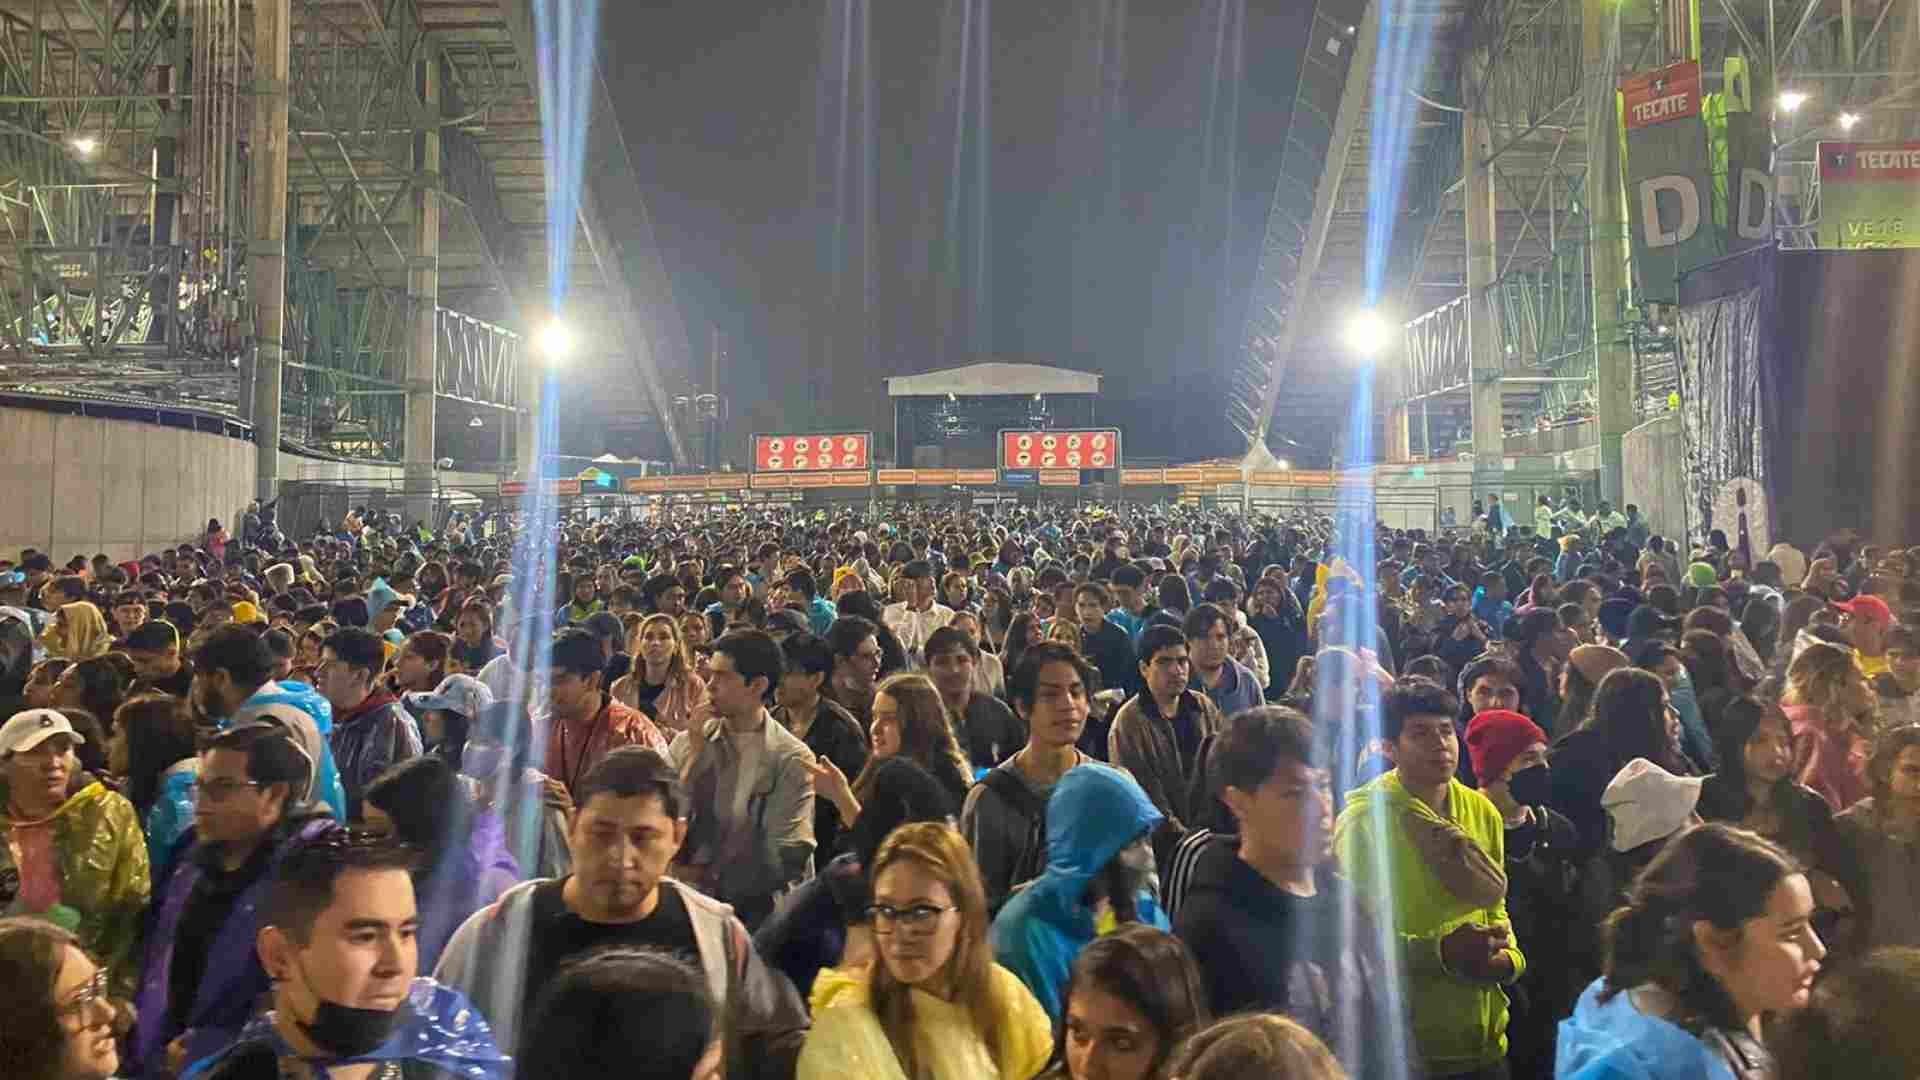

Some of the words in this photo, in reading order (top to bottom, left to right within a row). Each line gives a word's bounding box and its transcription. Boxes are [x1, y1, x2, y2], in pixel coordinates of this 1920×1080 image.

[1632, 93, 1689, 121] TECATE
[1856, 152, 1920, 169] TECATE
[1640, 175, 1700, 248] D
[1737, 168, 1774, 240] D
